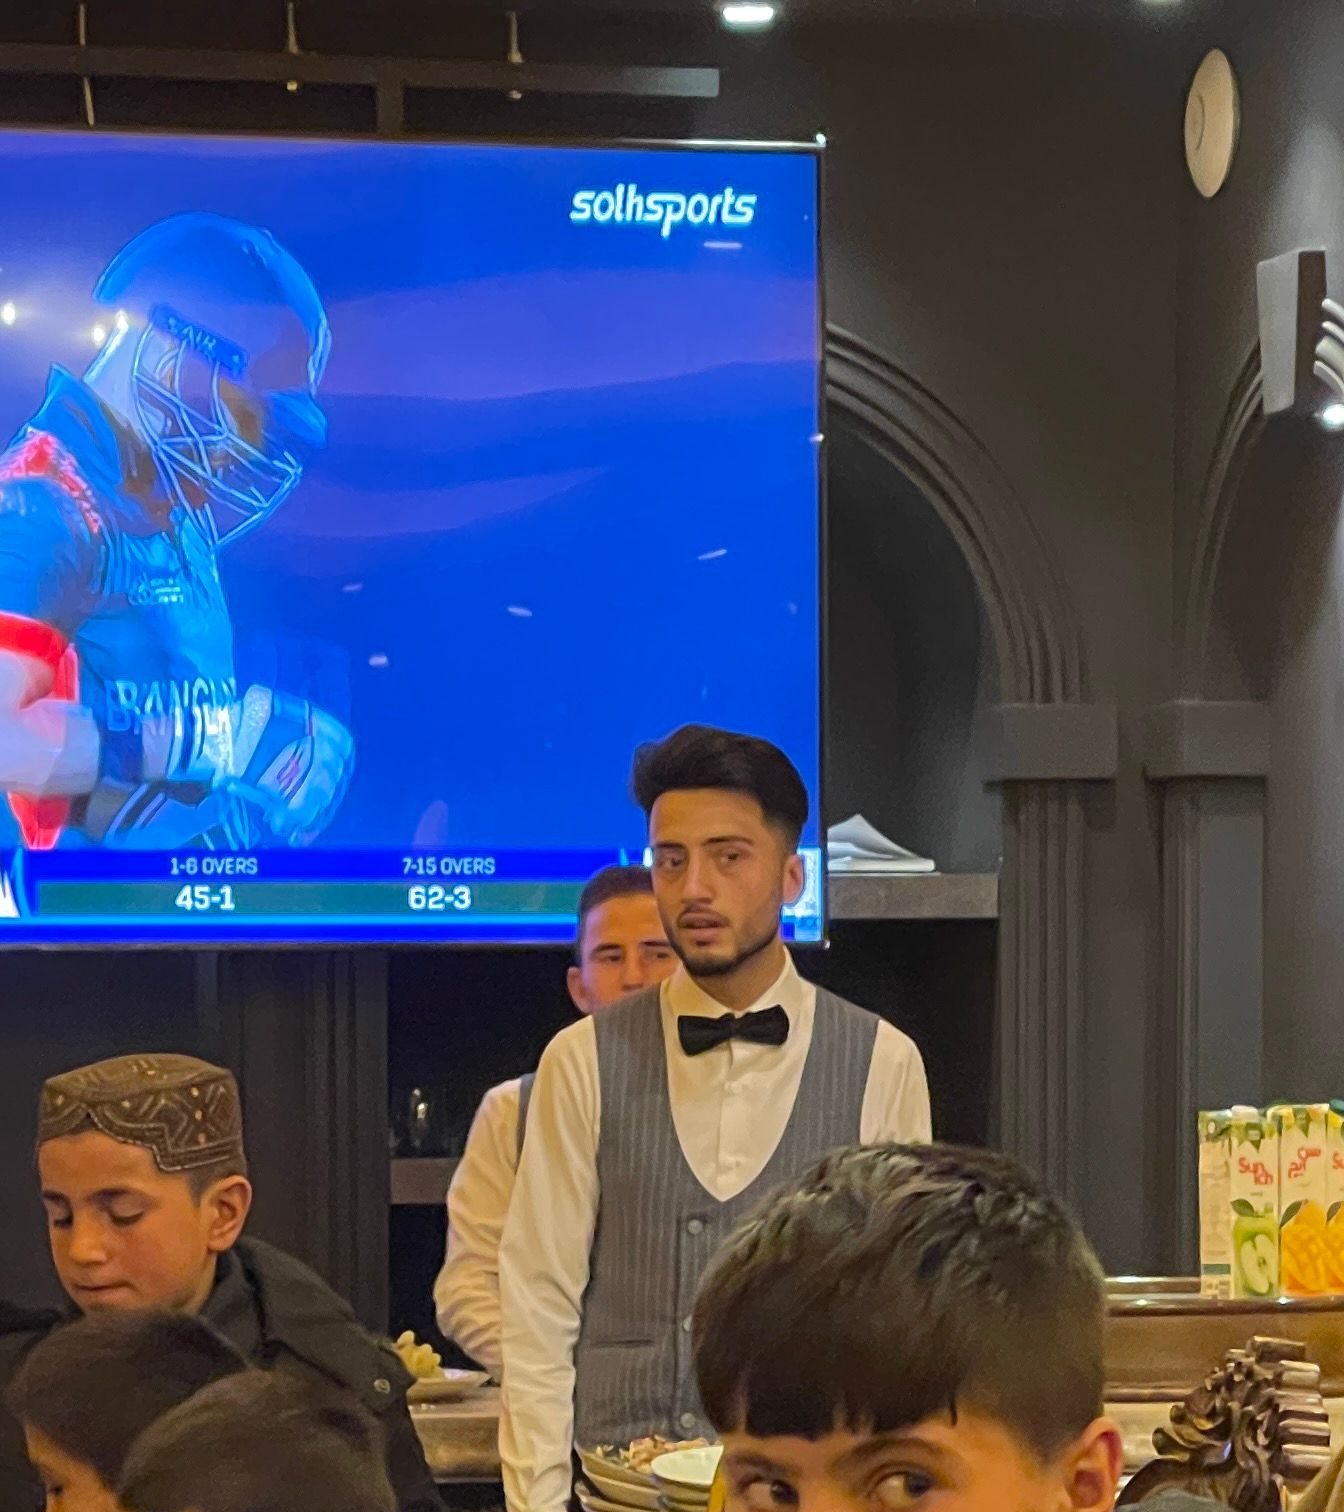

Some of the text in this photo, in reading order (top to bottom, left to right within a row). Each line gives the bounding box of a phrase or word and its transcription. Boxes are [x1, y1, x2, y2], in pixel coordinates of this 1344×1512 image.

[569, 182, 757, 239] solhsports
[201, 857, 258, 875] OVERS
[402, 857, 496, 875] 7-15 OVERS
[174, 884, 235, 911] 45-1
[408, 884, 472, 911] 62-3
